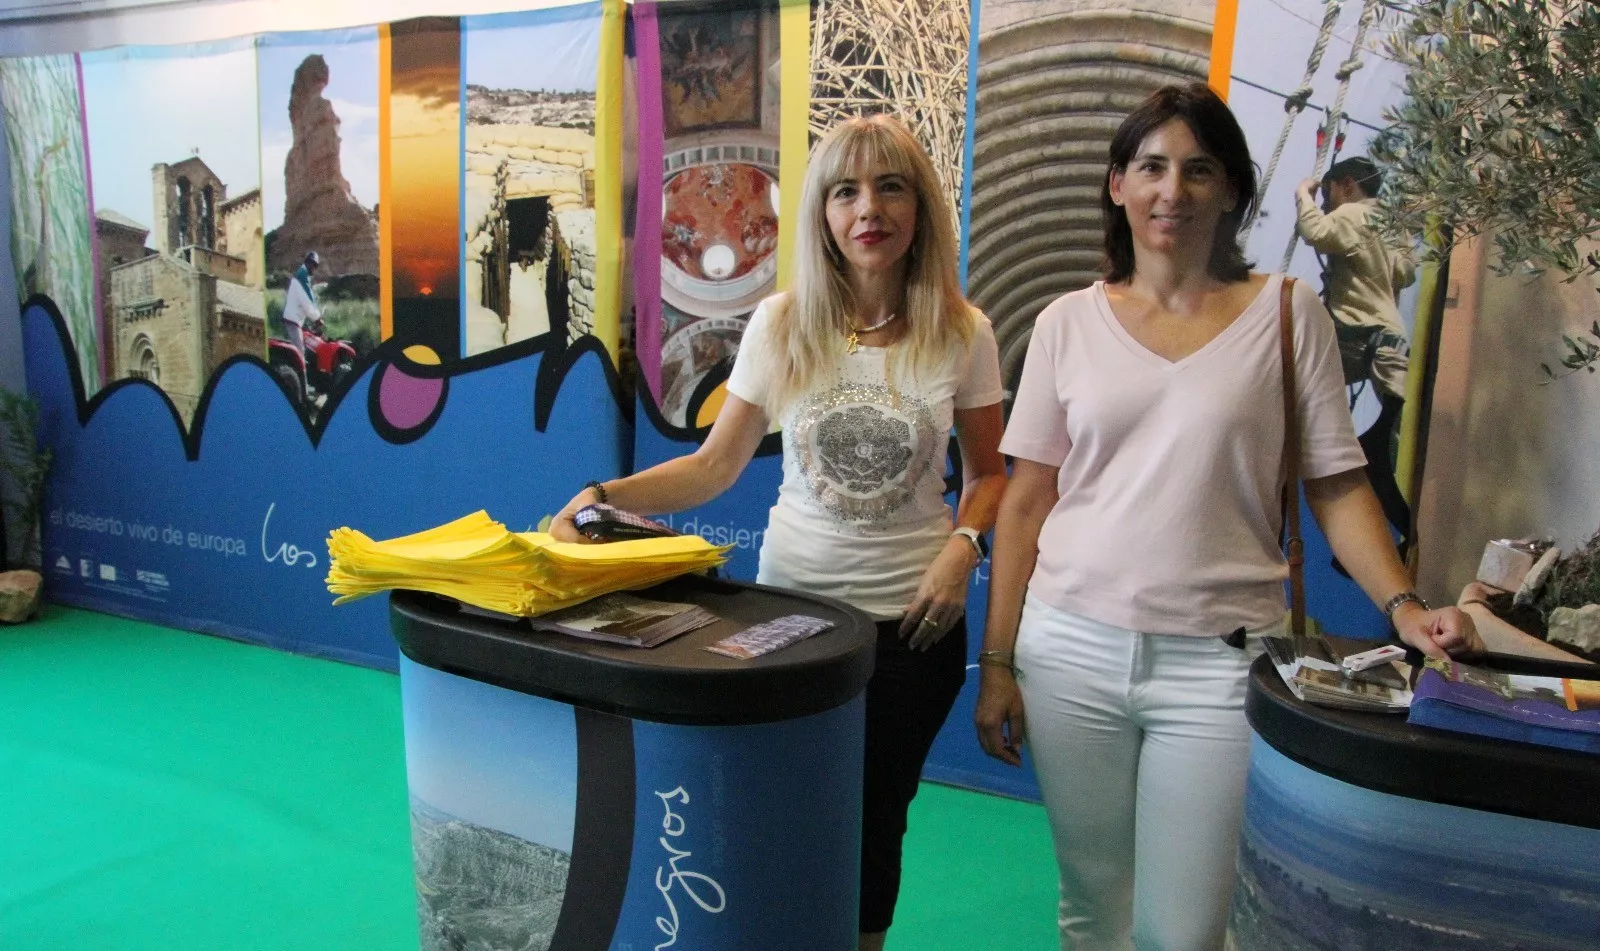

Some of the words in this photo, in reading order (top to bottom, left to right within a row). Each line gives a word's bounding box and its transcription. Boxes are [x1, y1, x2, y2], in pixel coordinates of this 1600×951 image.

[66, 509, 123, 536] desierto
[127, 518, 158, 541] vivo
[162, 523, 183, 545] de
[187, 531, 247, 557] europa
[682, 516, 766, 550] desier
